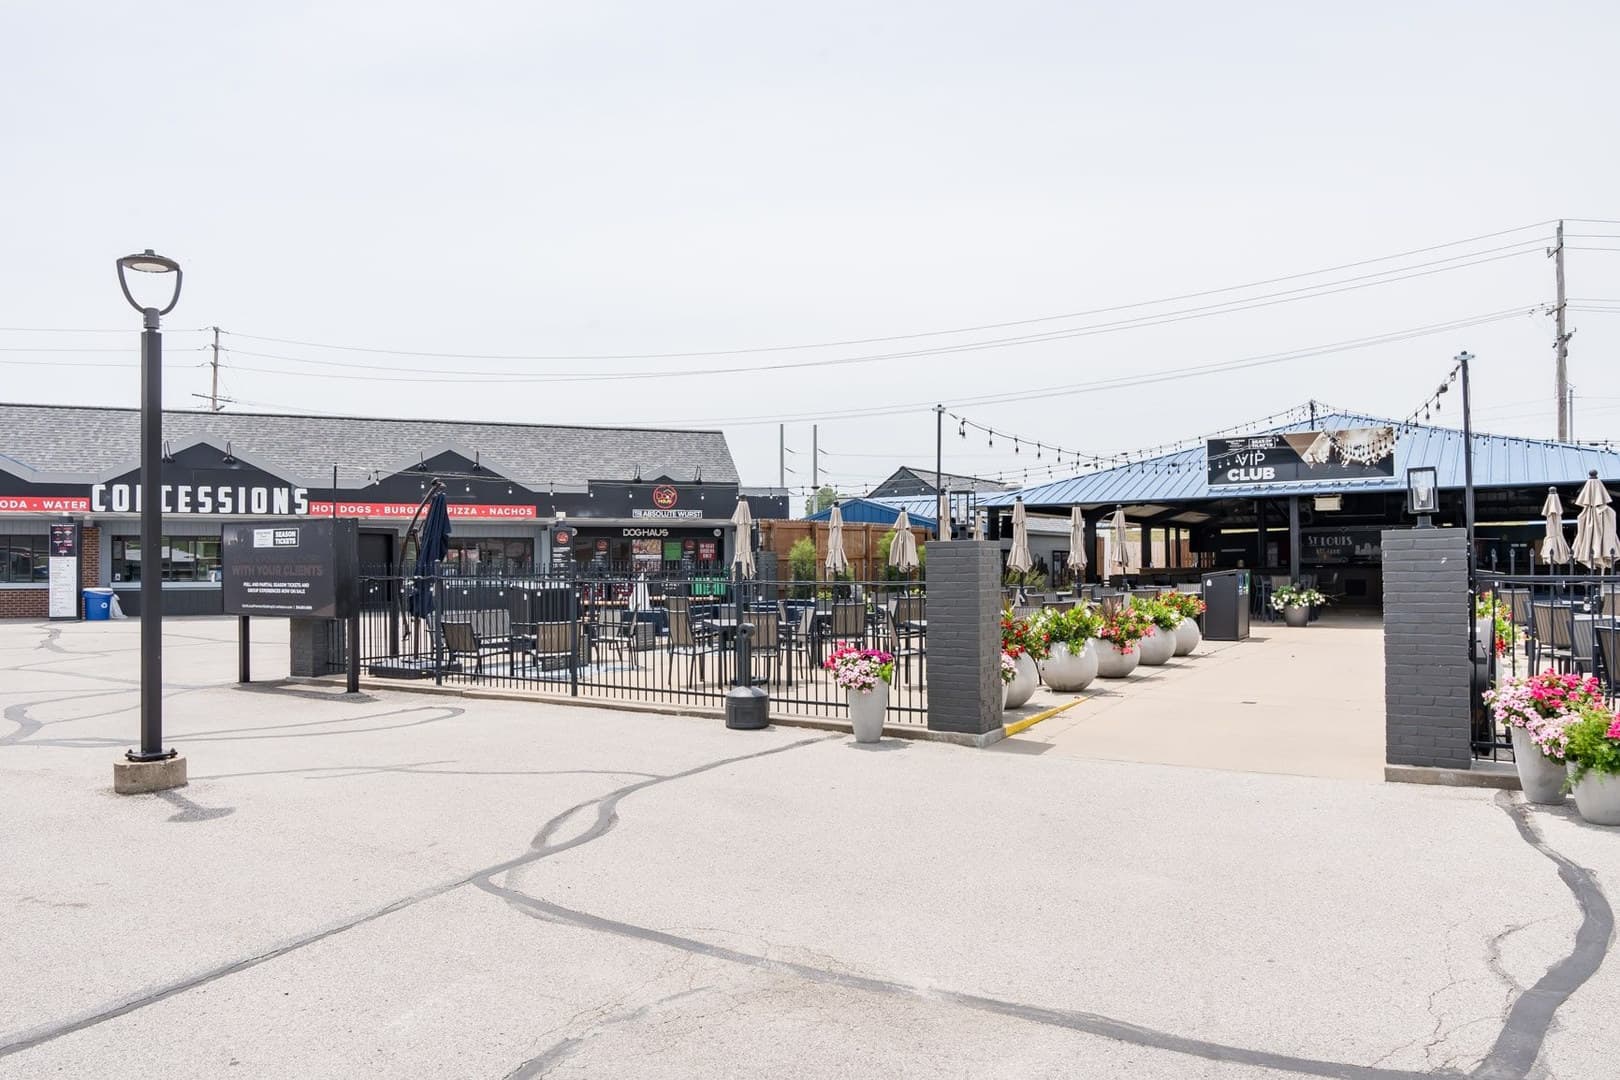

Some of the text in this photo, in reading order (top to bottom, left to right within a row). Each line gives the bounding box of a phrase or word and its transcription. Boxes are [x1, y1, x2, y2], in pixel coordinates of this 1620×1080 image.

[1236, 452, 1265, 466] VIP
[1227, 467, 1275, 481] CLUB
[0, 500, 87, 509] ODA WATER
[92, 484, 308, 515] COCESSIONS
[312, 504, 533, 515] HOT DOGS BURGER PIZZA NACHOS
[275, 530, 297, 538] SEASON
[1321, 535, 1352, 546] LOUIS
[231, 564, 322, 577] WITH YOUR CLIENTS
